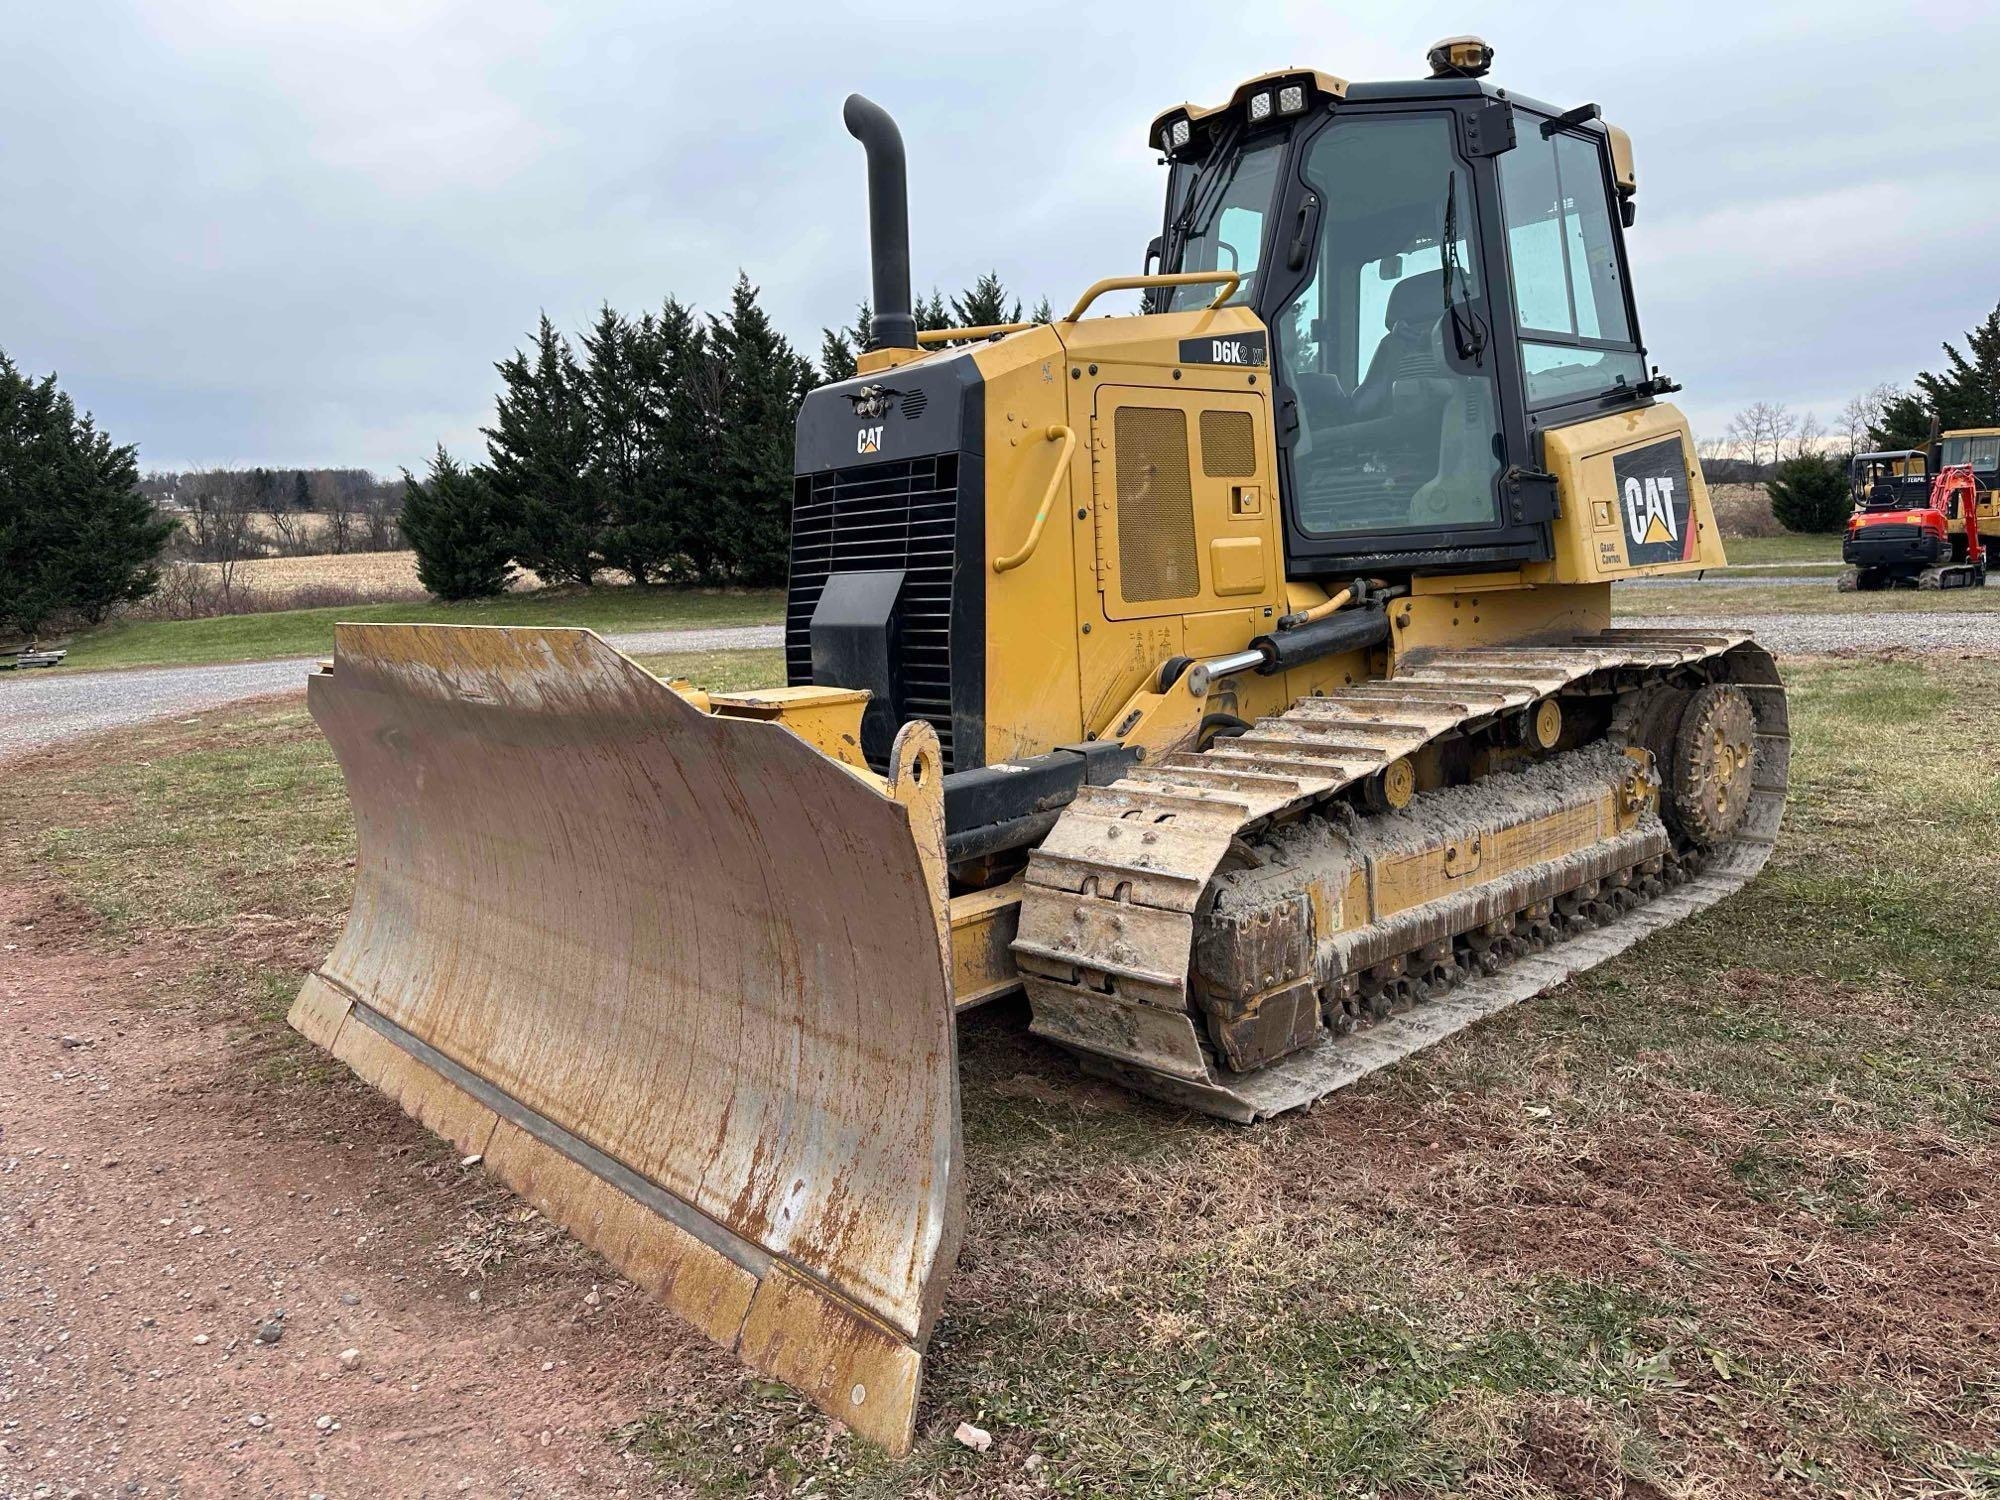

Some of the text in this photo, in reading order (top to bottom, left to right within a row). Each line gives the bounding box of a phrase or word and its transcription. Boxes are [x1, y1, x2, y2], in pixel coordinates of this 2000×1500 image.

[857, 426, 884, 454] CAT
[1624, 477, 1679, 545] CAT
[1602, 554, 1622, 565] CONTROL
